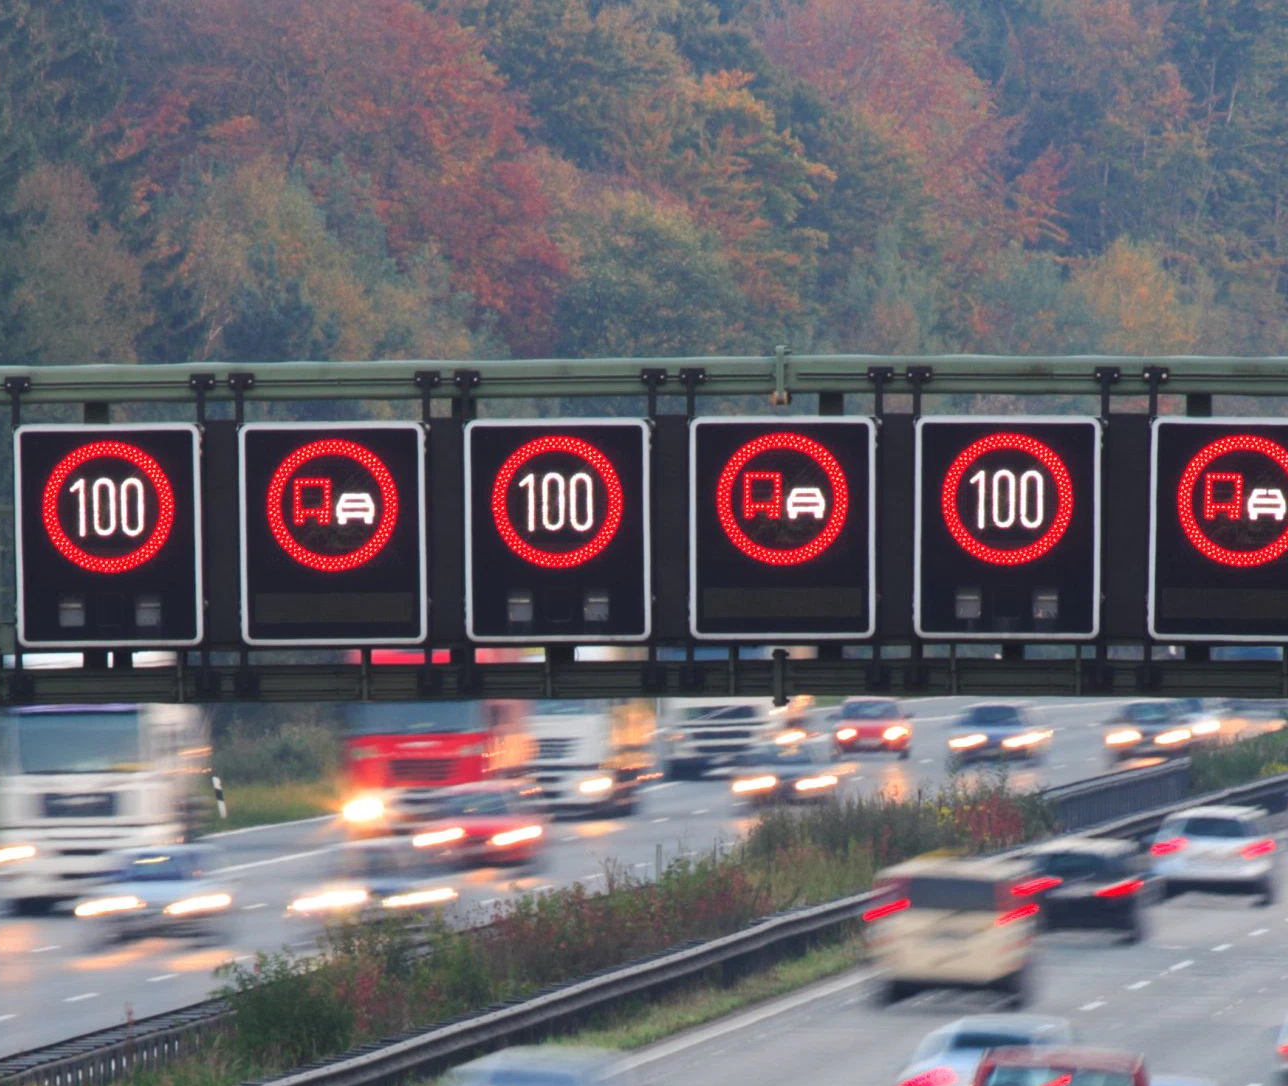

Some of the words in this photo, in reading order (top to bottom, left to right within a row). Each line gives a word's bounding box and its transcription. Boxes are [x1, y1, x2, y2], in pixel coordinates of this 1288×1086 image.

[68, 477, 145, 538] 100
[518, 472, 594, 532] 100
[969, 469, 1045, 530] 100
